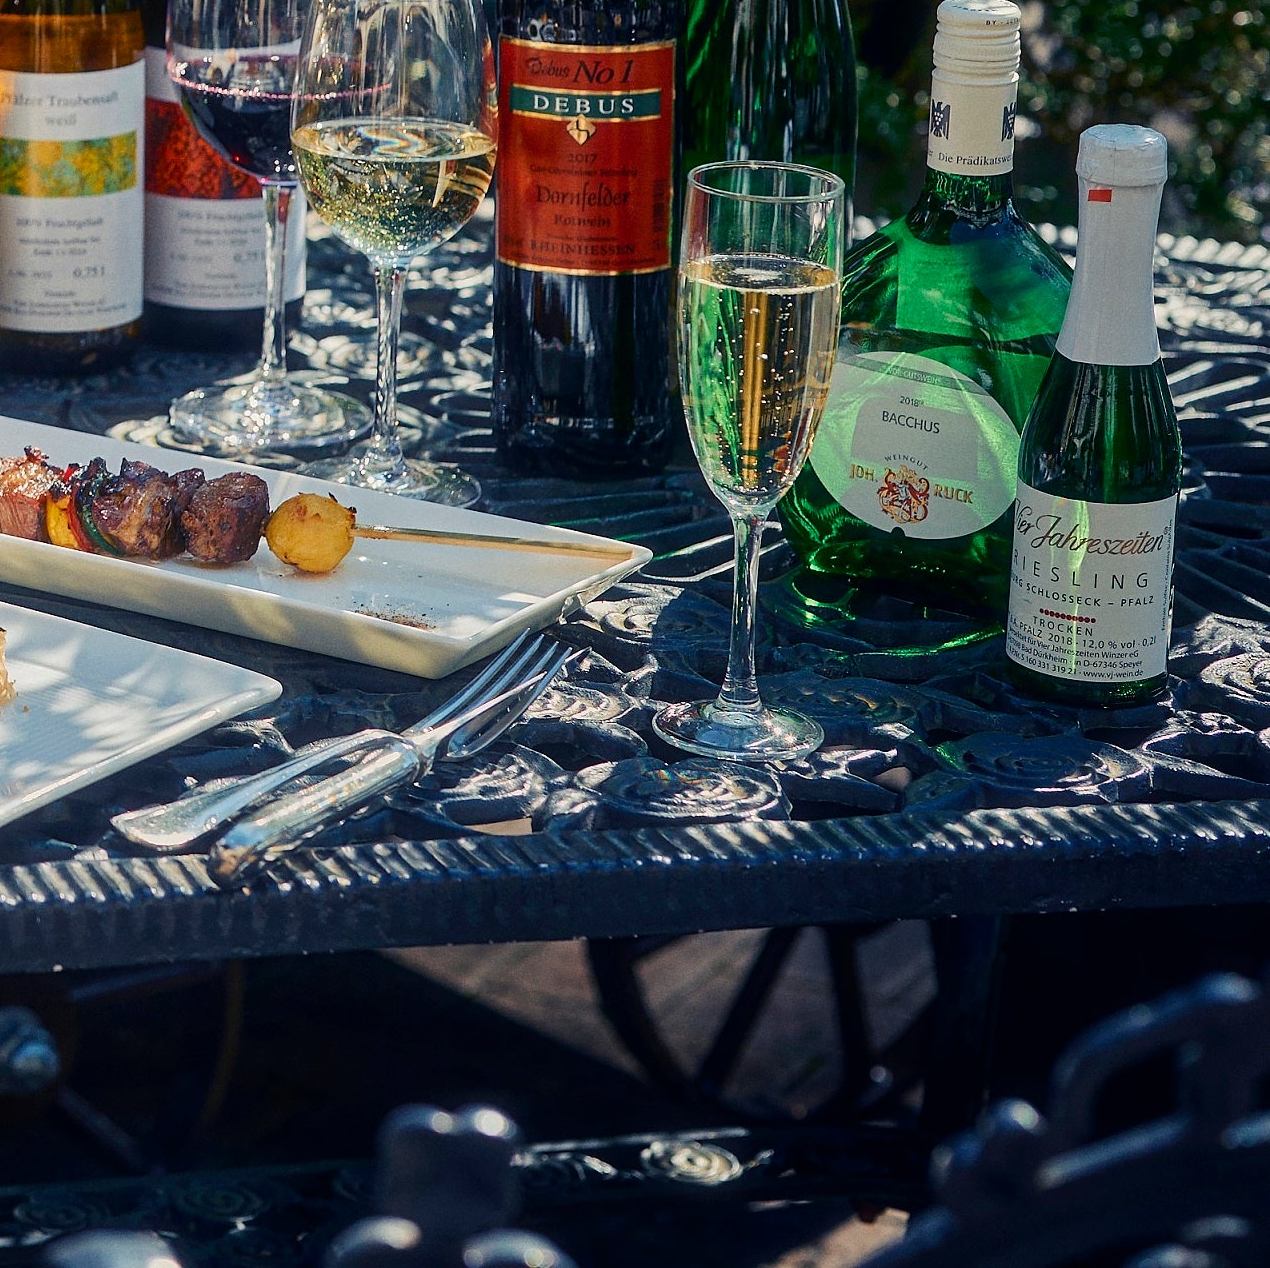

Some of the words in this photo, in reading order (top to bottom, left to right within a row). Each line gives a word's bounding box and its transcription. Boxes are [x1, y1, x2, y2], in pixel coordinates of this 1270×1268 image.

[526, 57, 571, 79] Debus
[572, 59, 615, 84] No
[533, 94, 635, 115] DEBUS
[45, 111, 77, 127] weiß
[567, 152, 598, 164] 2017
[938, 152, 954, 163] Die
[536, 182, 631, 212] Dornfelder
[554, 214, 612, 228] Rotwein
[530, 240, 636, 256] RHEINHESSEN
[882, 410, 940, 434] BACCHUS
[884, 453, 929, 471] WEINGUT
[849, 463, 878, 483] JOH.
[933, 483, 974, 504] RUCK
[1015, 497, 1035, 536] Vier
[1031, 514, 1164, 556] Jahreszeiten
[1013, 548, 1149, 589] RIESLING
[1026, 582, 1102, 607] SCHLOSSECK
[1120, 595, 1155, 607] PFALZ
[1019, 621, 1043, 639] PFALZ
[1047, 633, 1073, 645] 2018
[1082, 639, 1105, 650] 12,0
[1107, 640, 1118, 650] %
[1121, 639, 1136, 649] vol
[1033, 615, 1094, 637] TROCKEN
[1021, 643, 1033, 654] Bad
[1033, 648, 1068, 664] Dürkheim
[1083, 659, 1117, 670] D-67346
[1119, 659, 1143, 670] Speyer
[1052, 644, 1100, 658] Jahreszeiten
[1101, 651, 1128, 659] Winzer
[1026, 655, 1037, 666] 160
[1037, 661, 1050, 670] 331
[1052, 665, 1066, 674] 319
[1068, 667, 1077, 675] 21
